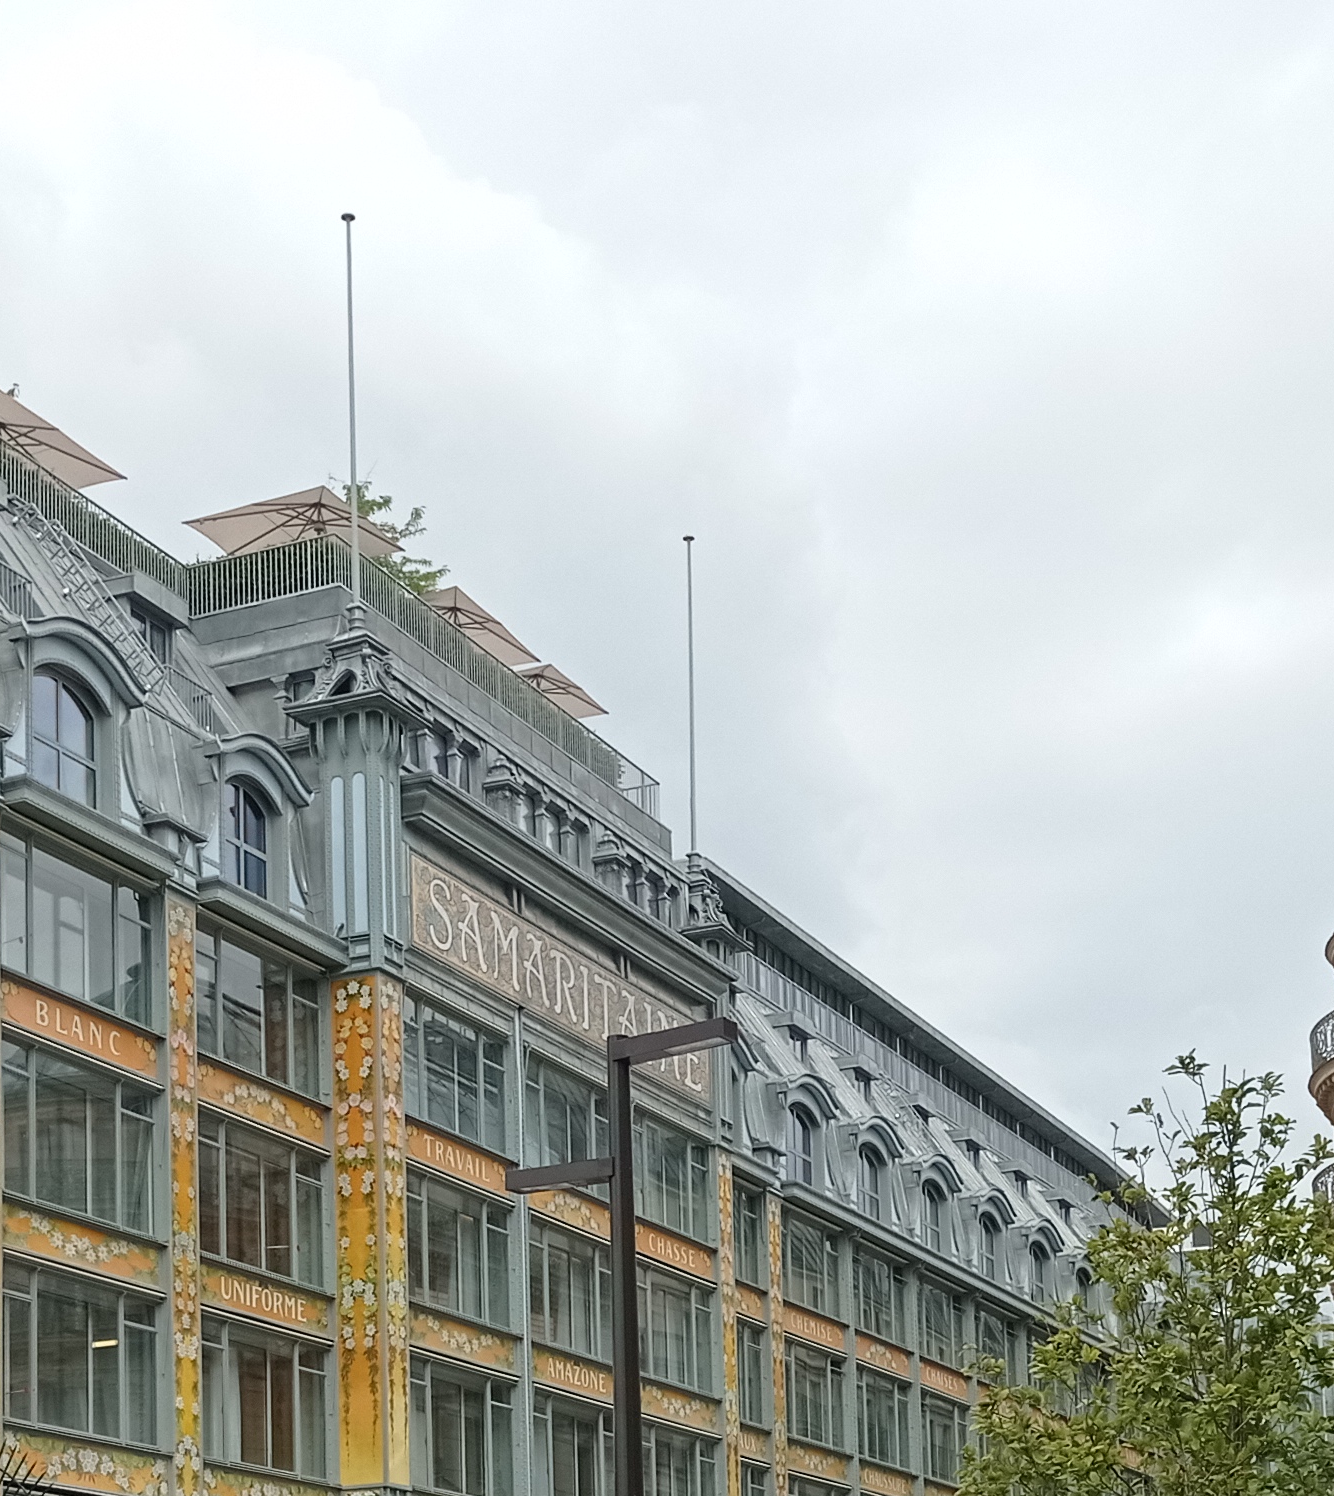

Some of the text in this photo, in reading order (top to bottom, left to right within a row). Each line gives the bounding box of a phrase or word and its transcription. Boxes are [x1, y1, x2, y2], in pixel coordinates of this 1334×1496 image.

[35, 999, 123, 1057] BLANC
[423, 1133, 490, 1183] TRAVAIL
[648, 1232, 696, 1268] CHASSE
[219, 1274, 308, 1323] UNIFORME
[790, 1312, 833, 1342] CHEMISE
[547, 1357, 607, 1394] AMAZONE
